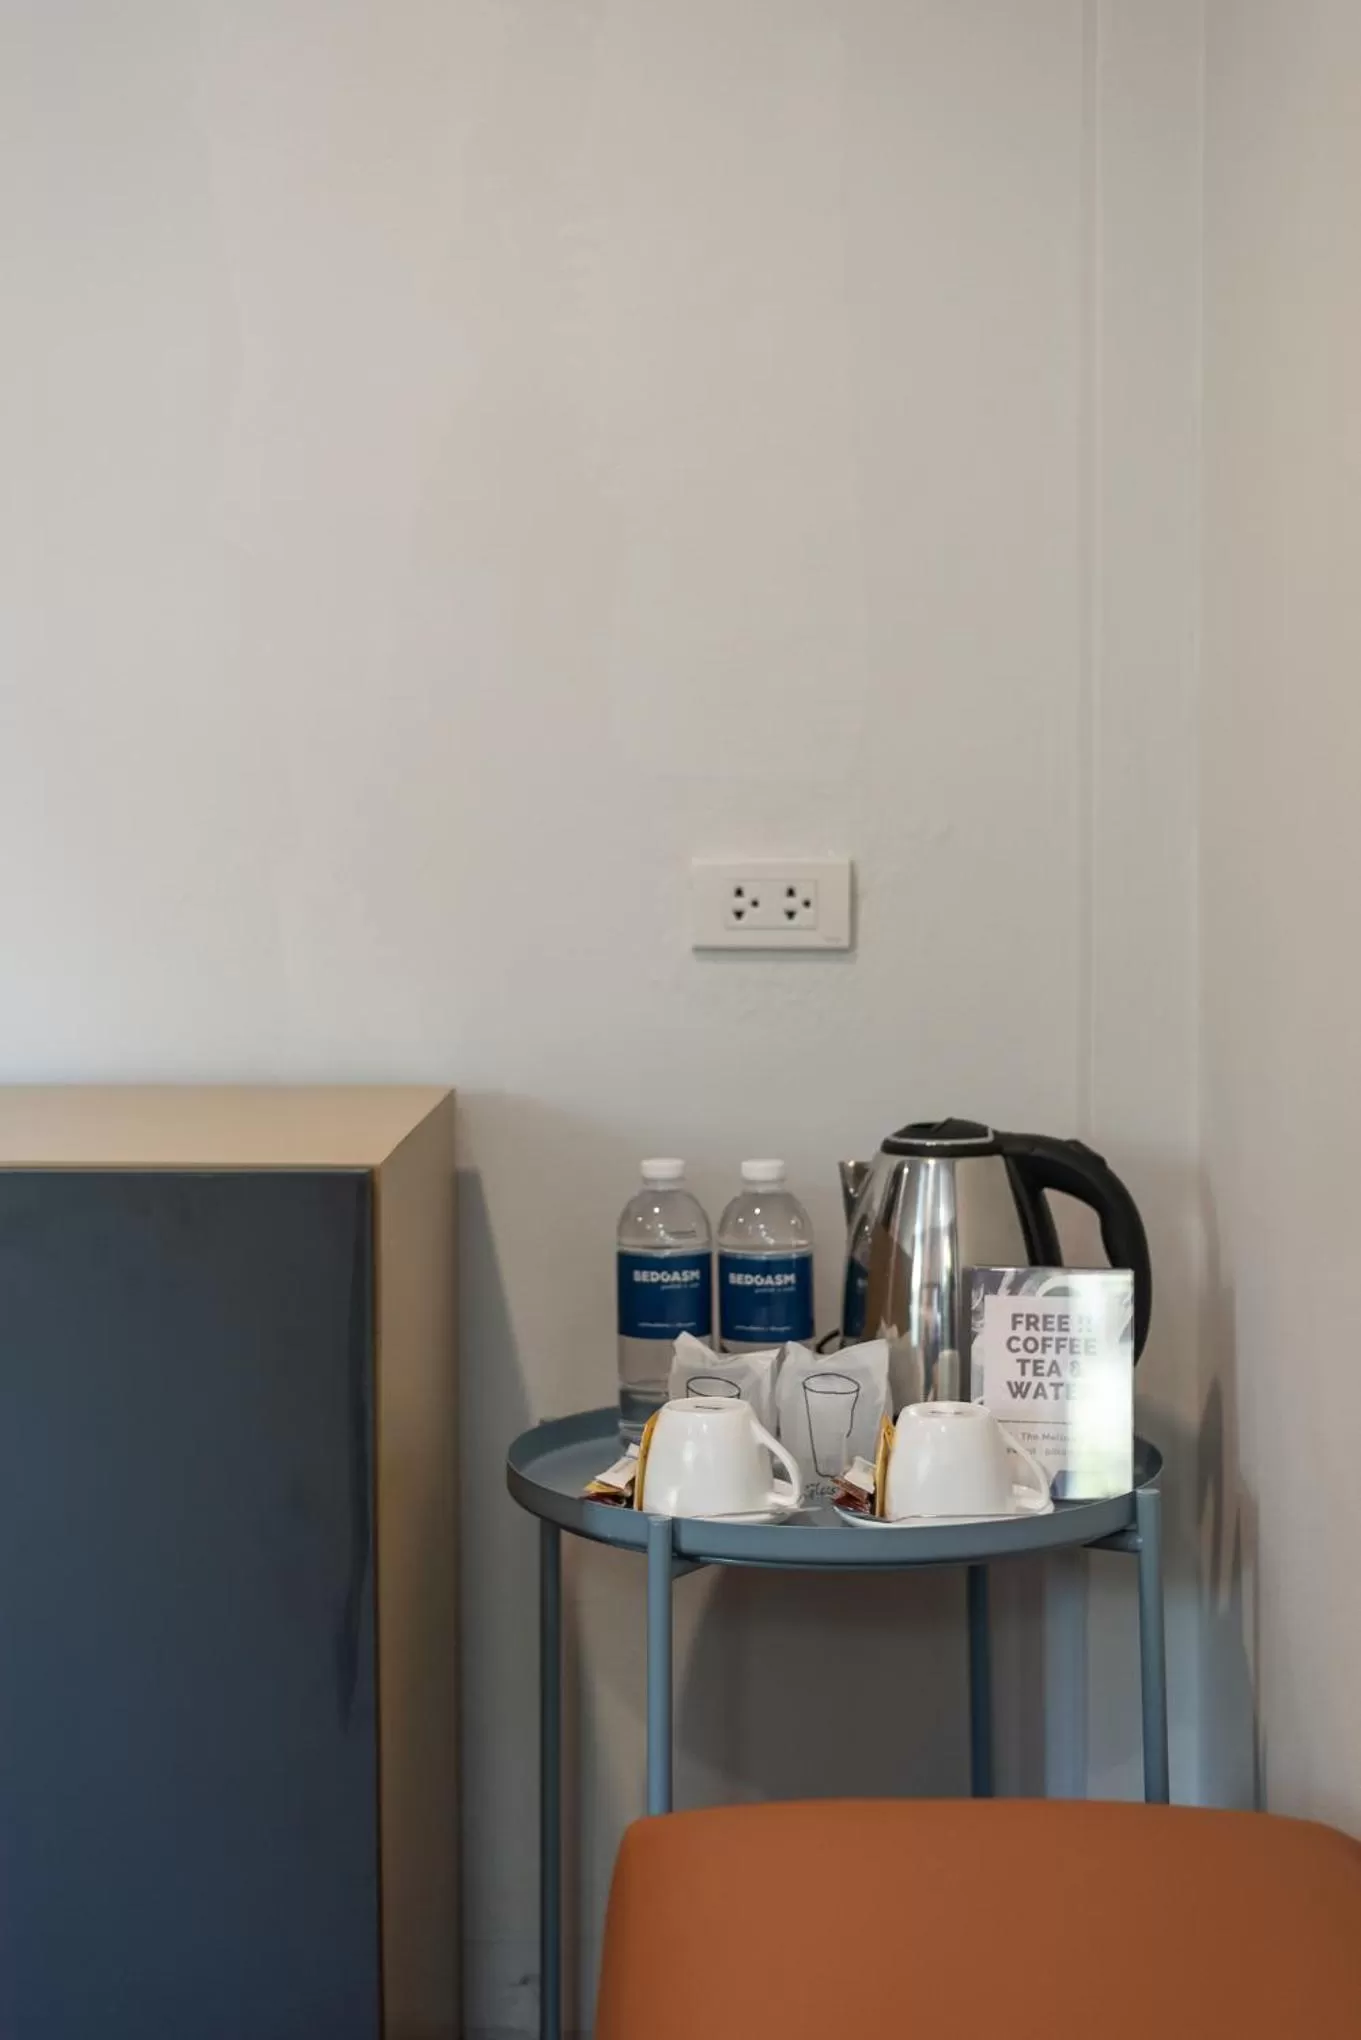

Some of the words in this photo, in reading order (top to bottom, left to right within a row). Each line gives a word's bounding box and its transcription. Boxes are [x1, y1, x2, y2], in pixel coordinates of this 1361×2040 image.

[1011, 1313, 1070, 1332] FREE
[1005, 1336, 1096, 1355] COFFEE
[1016, 1358, 1063, 1377] TEA
[1006, 1380, 1090, 1400] WATE
